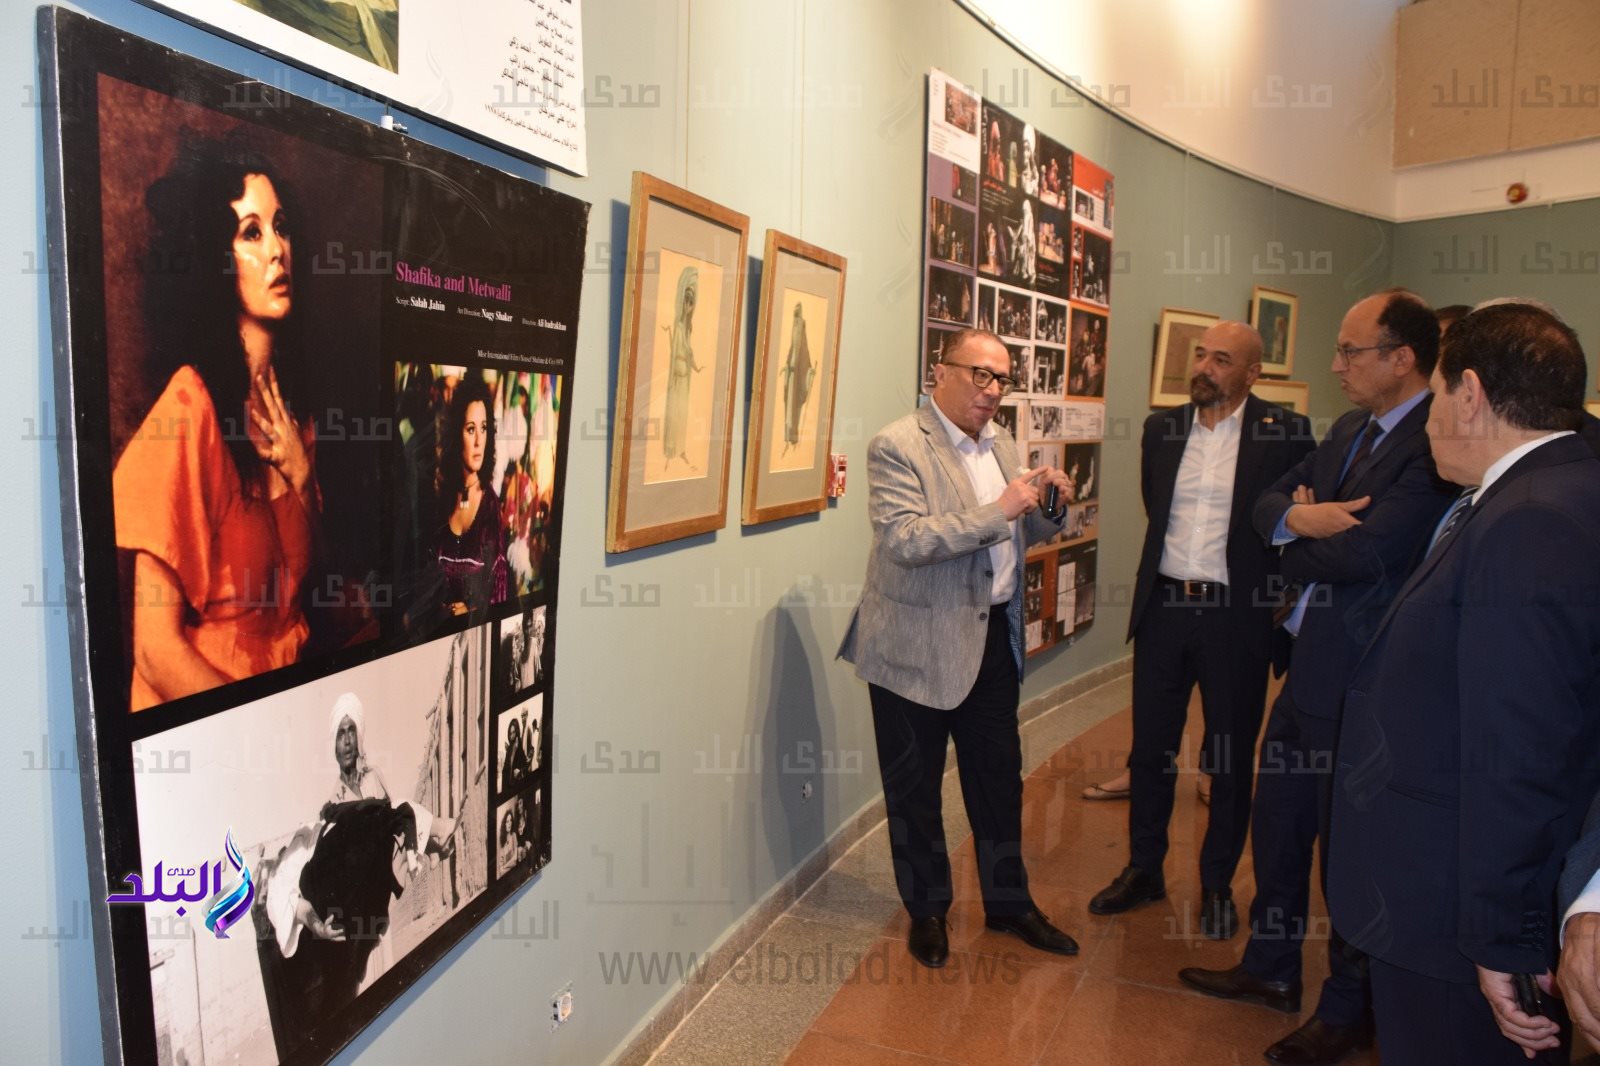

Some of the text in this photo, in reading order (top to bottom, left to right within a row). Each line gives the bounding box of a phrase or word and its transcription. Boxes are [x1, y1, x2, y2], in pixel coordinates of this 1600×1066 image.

[395, 261, 512, 302] Shafika and Metwalli
[411, 296, 428, 309] Salah
